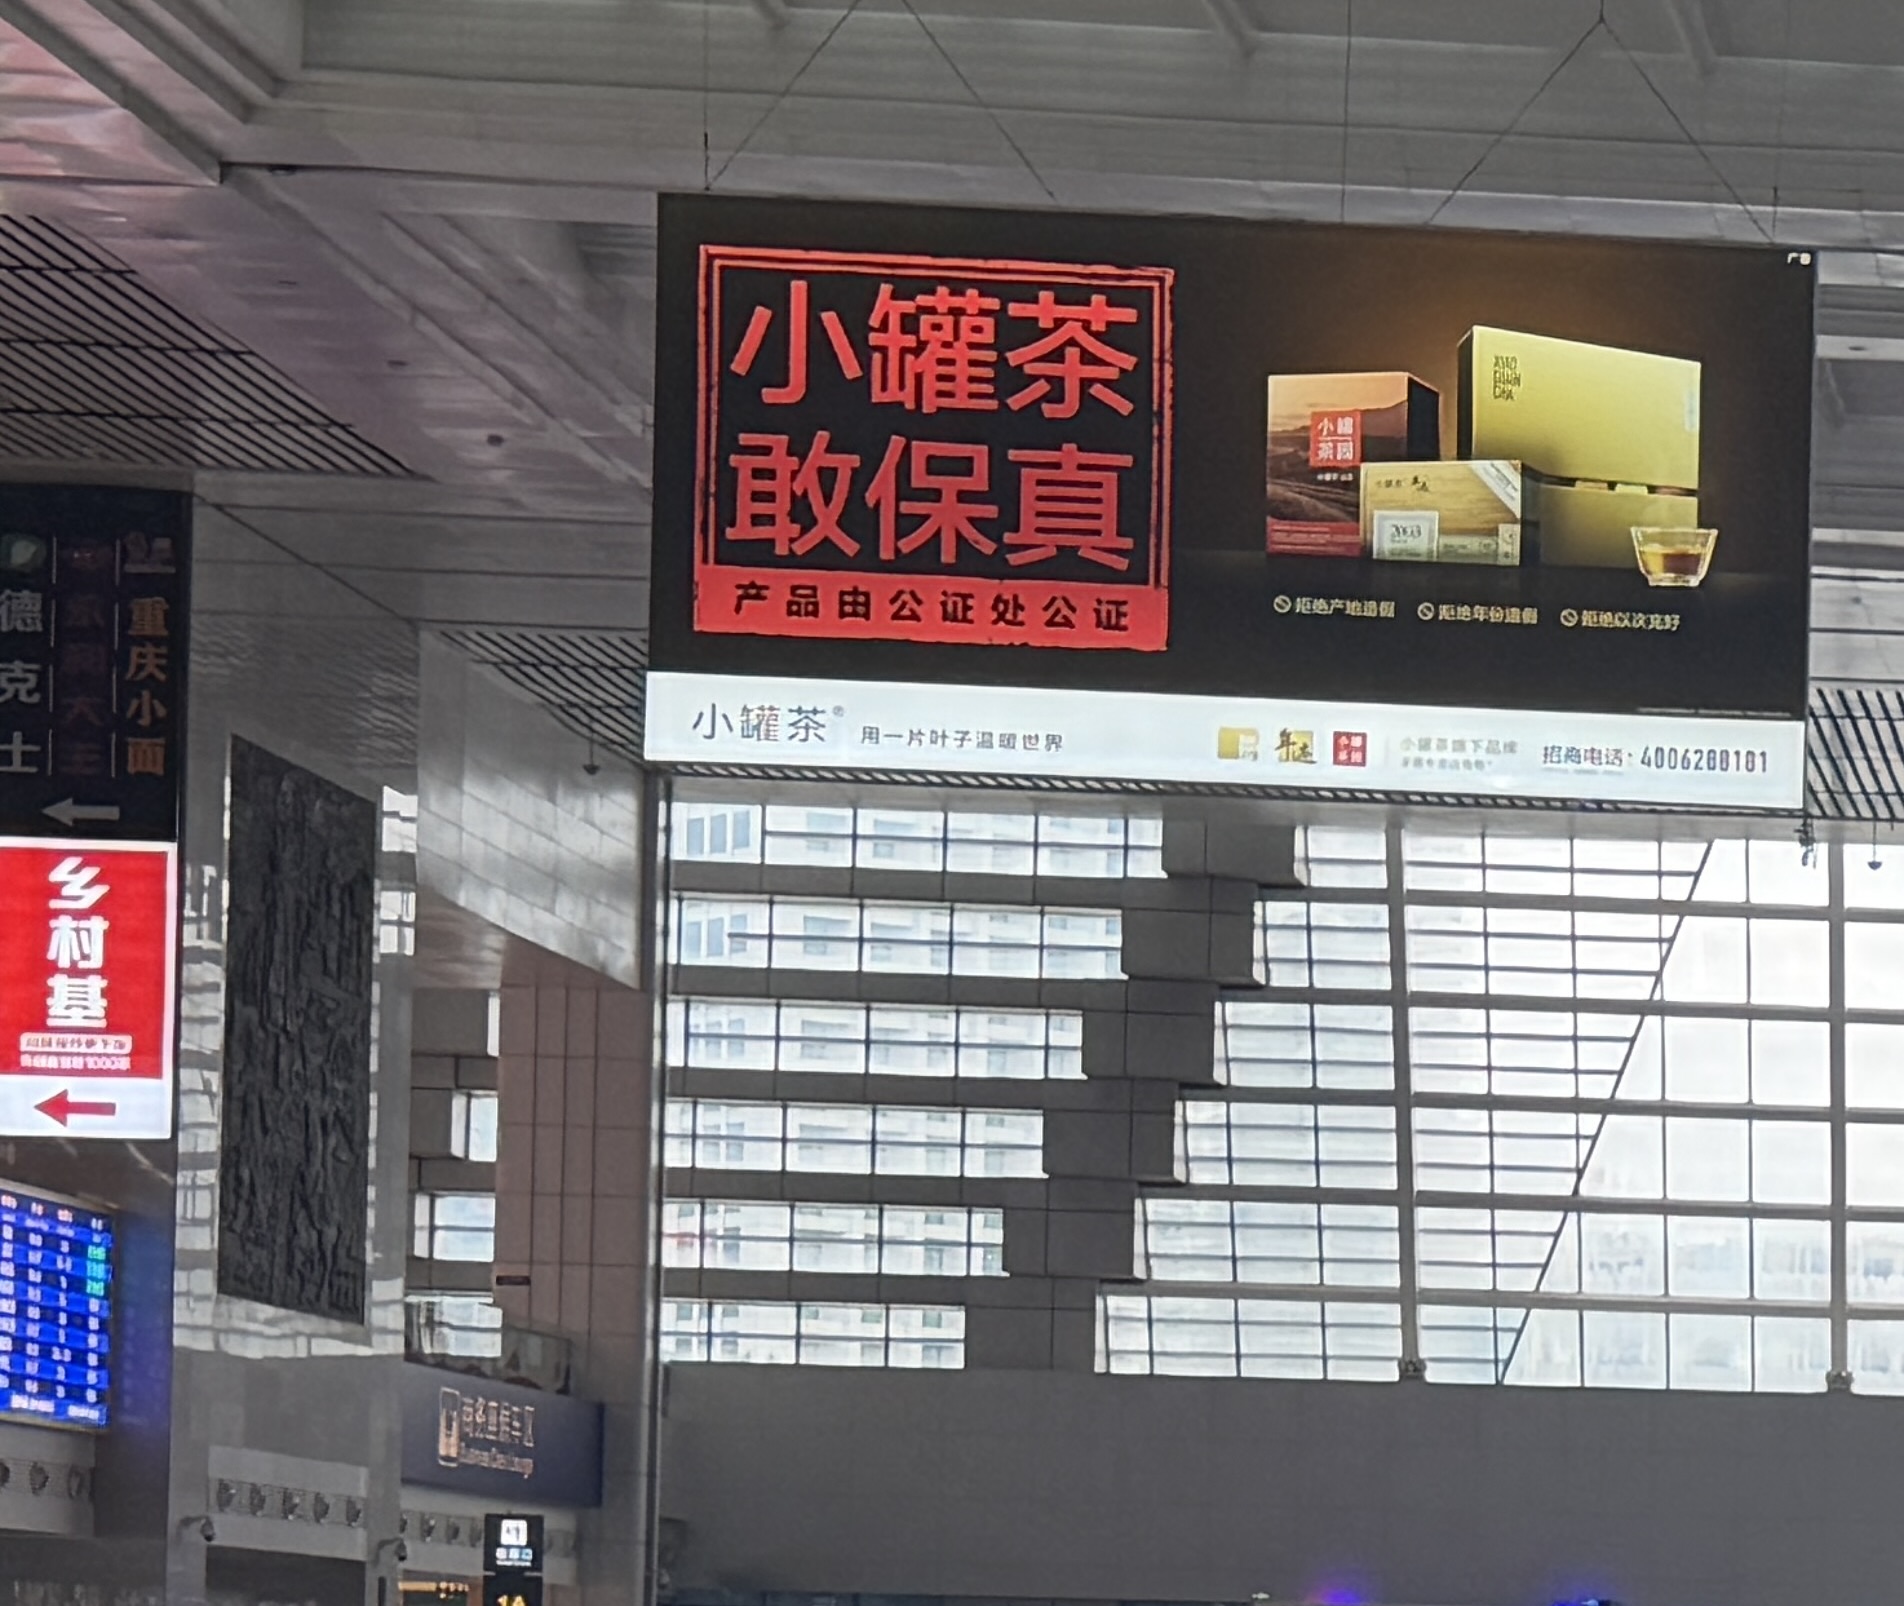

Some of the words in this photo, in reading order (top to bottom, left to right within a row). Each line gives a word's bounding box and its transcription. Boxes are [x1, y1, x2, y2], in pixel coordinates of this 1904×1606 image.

[730, 279, 1138, 419] 小罐茶
[726, 431, 1135, 571] 敢保真
[734, 581, 1130, 632] 产品由公证处公证
[125, 596, 170, 776] 重庆小面
[860, 725, 1064, 753] 用一片叶子温暖世界
[46, 856, 110, 1029] 乡村基
